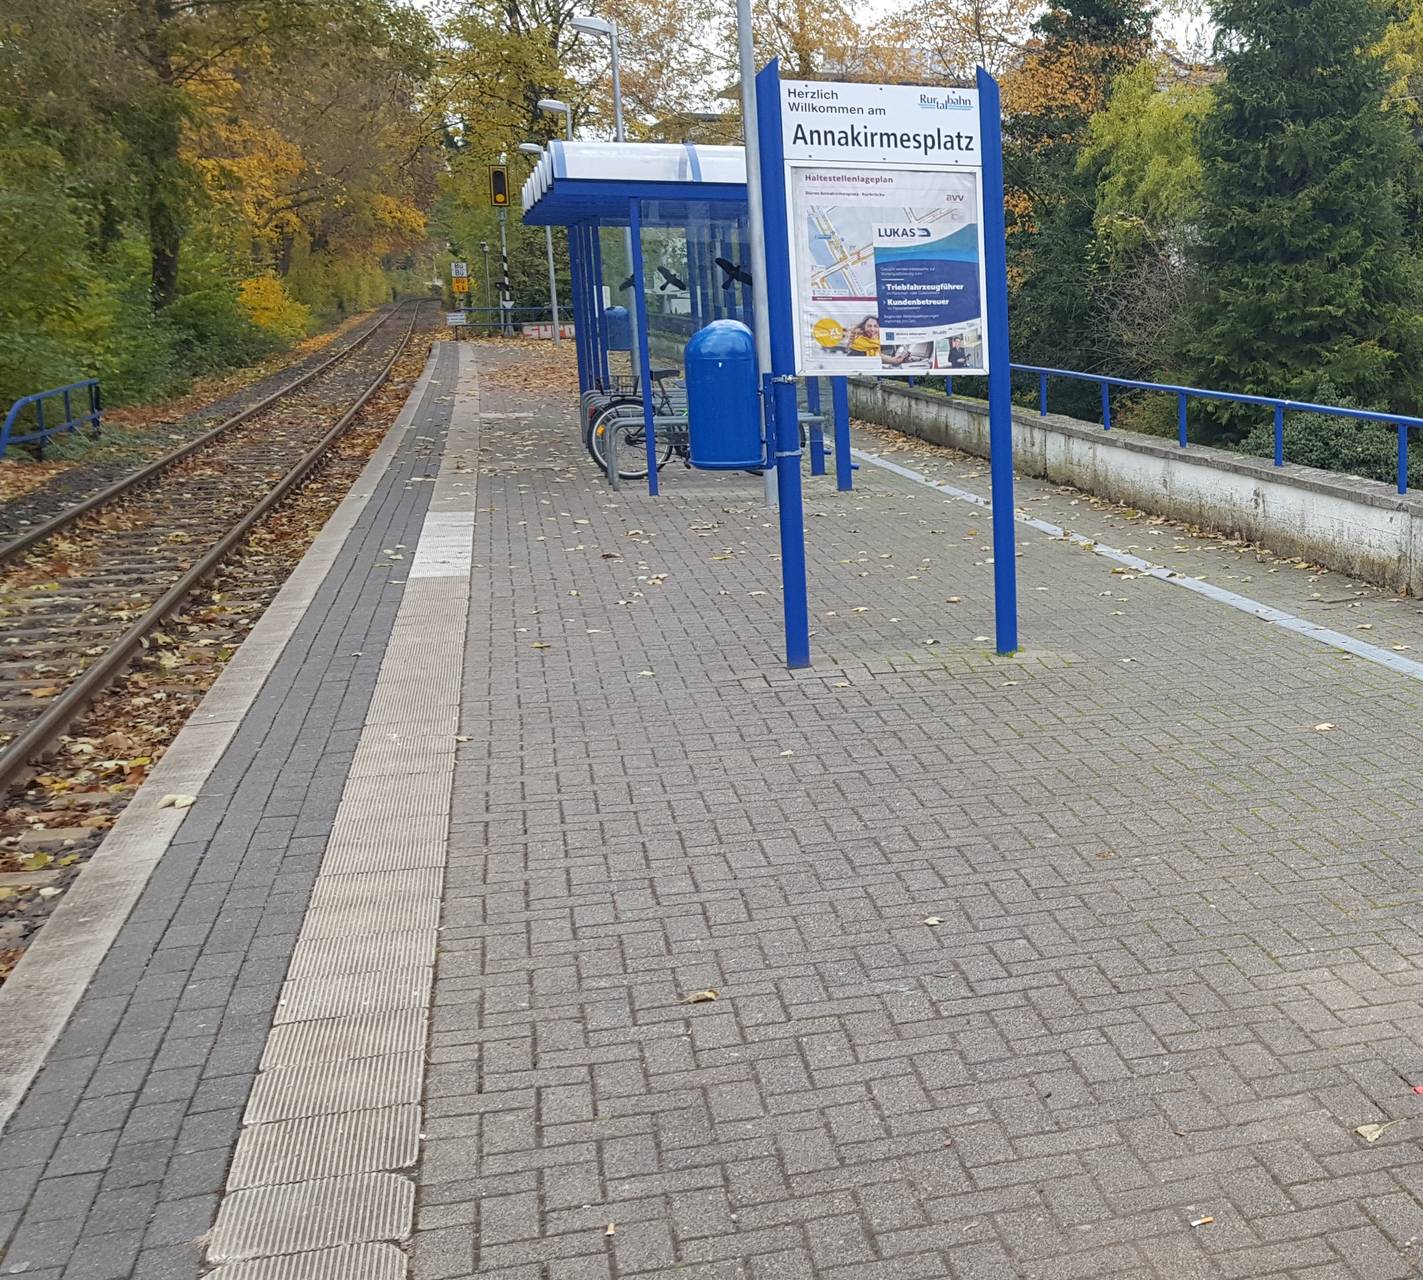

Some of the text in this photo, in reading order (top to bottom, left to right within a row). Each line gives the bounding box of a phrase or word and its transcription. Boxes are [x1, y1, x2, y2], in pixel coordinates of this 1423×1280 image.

[787, 87, 839, 101] Herzlich
[788, 101, 887, 116] Willkommen am
[792, 123, 975, 156] Annakirmesplatz
[804, 173, 894, 185] Haltestellenlageplan
[878, 227, 916, 238] LUKAS
[886, 283, 964, 292] Triebfahrzeugführer
[887, 298, 950, 306] Kundenbetreuer
